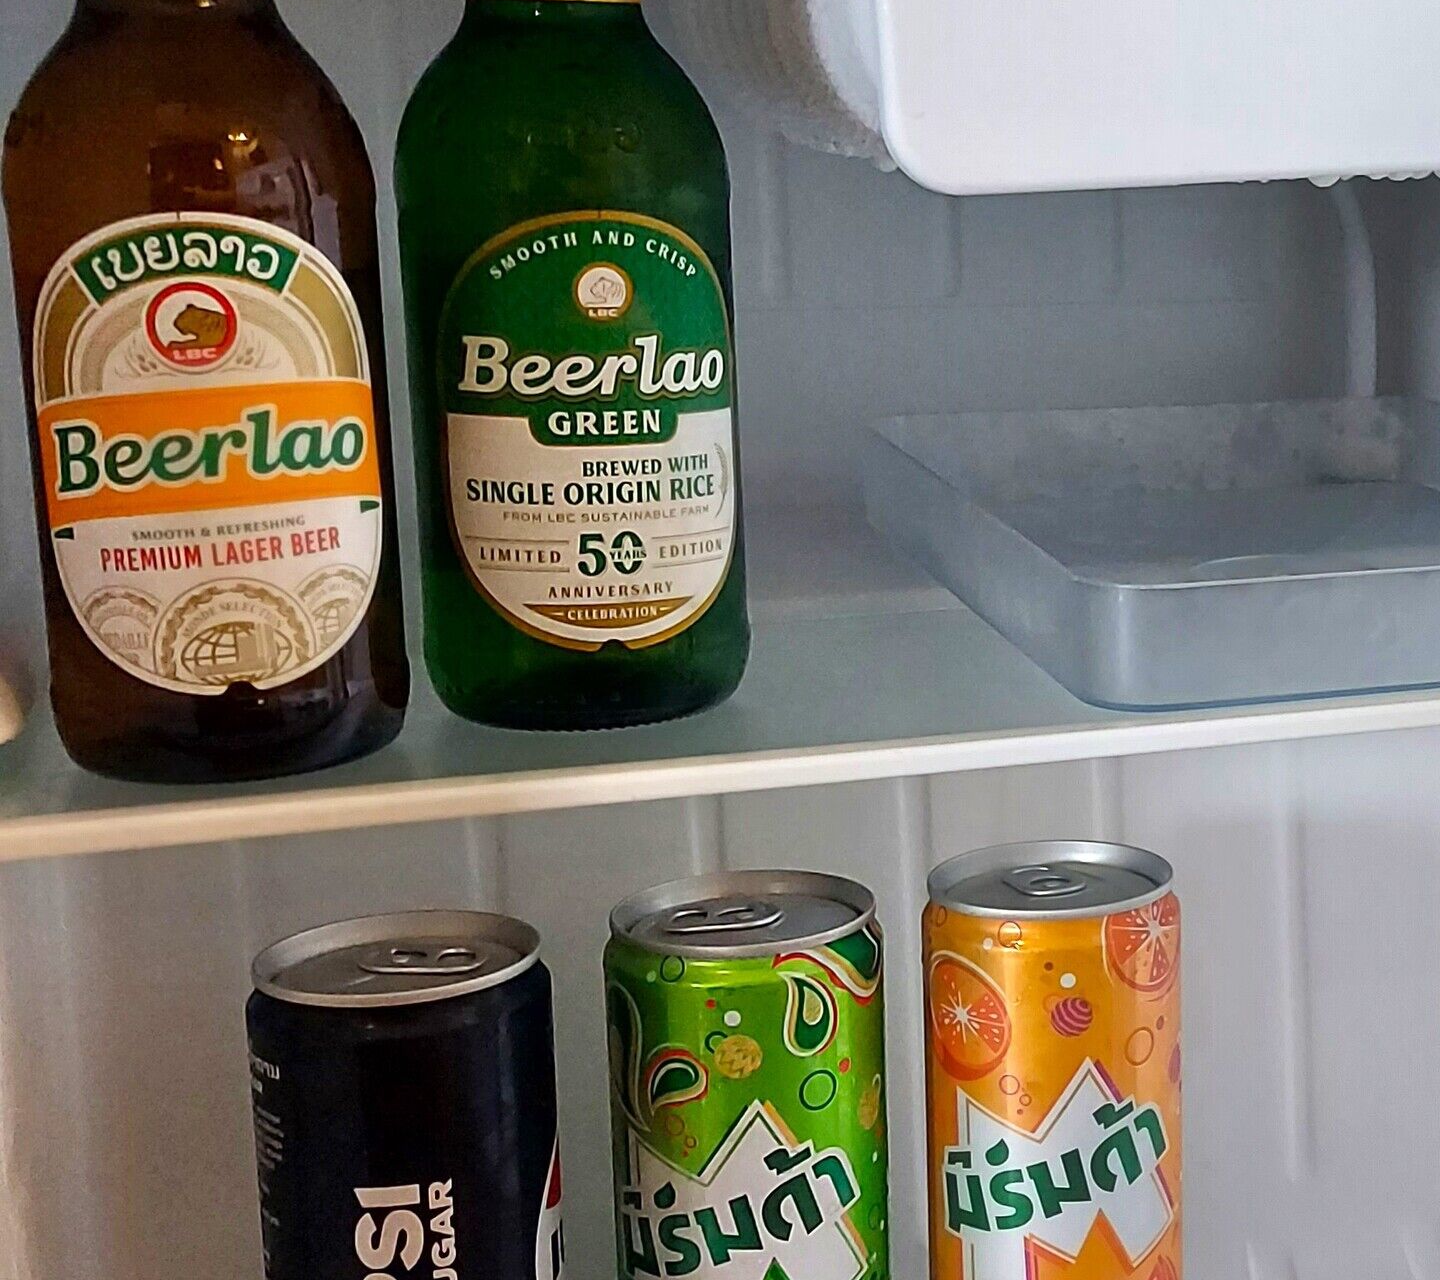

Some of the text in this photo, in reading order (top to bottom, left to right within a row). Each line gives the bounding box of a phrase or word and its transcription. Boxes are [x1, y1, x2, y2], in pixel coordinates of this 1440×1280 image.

[90, 229, 282, 290] ເບຍລາວ
[490, 230, 698, 281] SMOOTH AND CRISP
[172, 346, 219, 362] LBC
[458, 334, 726, 398] Beerlao
[547, 408, 662, 437] GREEN
[53, 410, 365, 495] Beerlao
[582, 453, 710, 478] BREWED WITH
[466, 473, 715, 506] SINGLE ORIGIN RICE
[132, 514, 306, 542] SMOOTH & REFRESHING
[502, 504, 710, 524] FROM LBC SUSTAINABLE FARM
[100, 526, 341, 574] PREMIUM LAGER BEER
[479, 545, 562, 565] LIMITED
[658, 538, 724, 560] EDITION
[608, 548, 647, 562] YEARS
[548, 580, 673, 601] ANNIVERSARY
[567, 605, 659, 621] CELEBRATION
